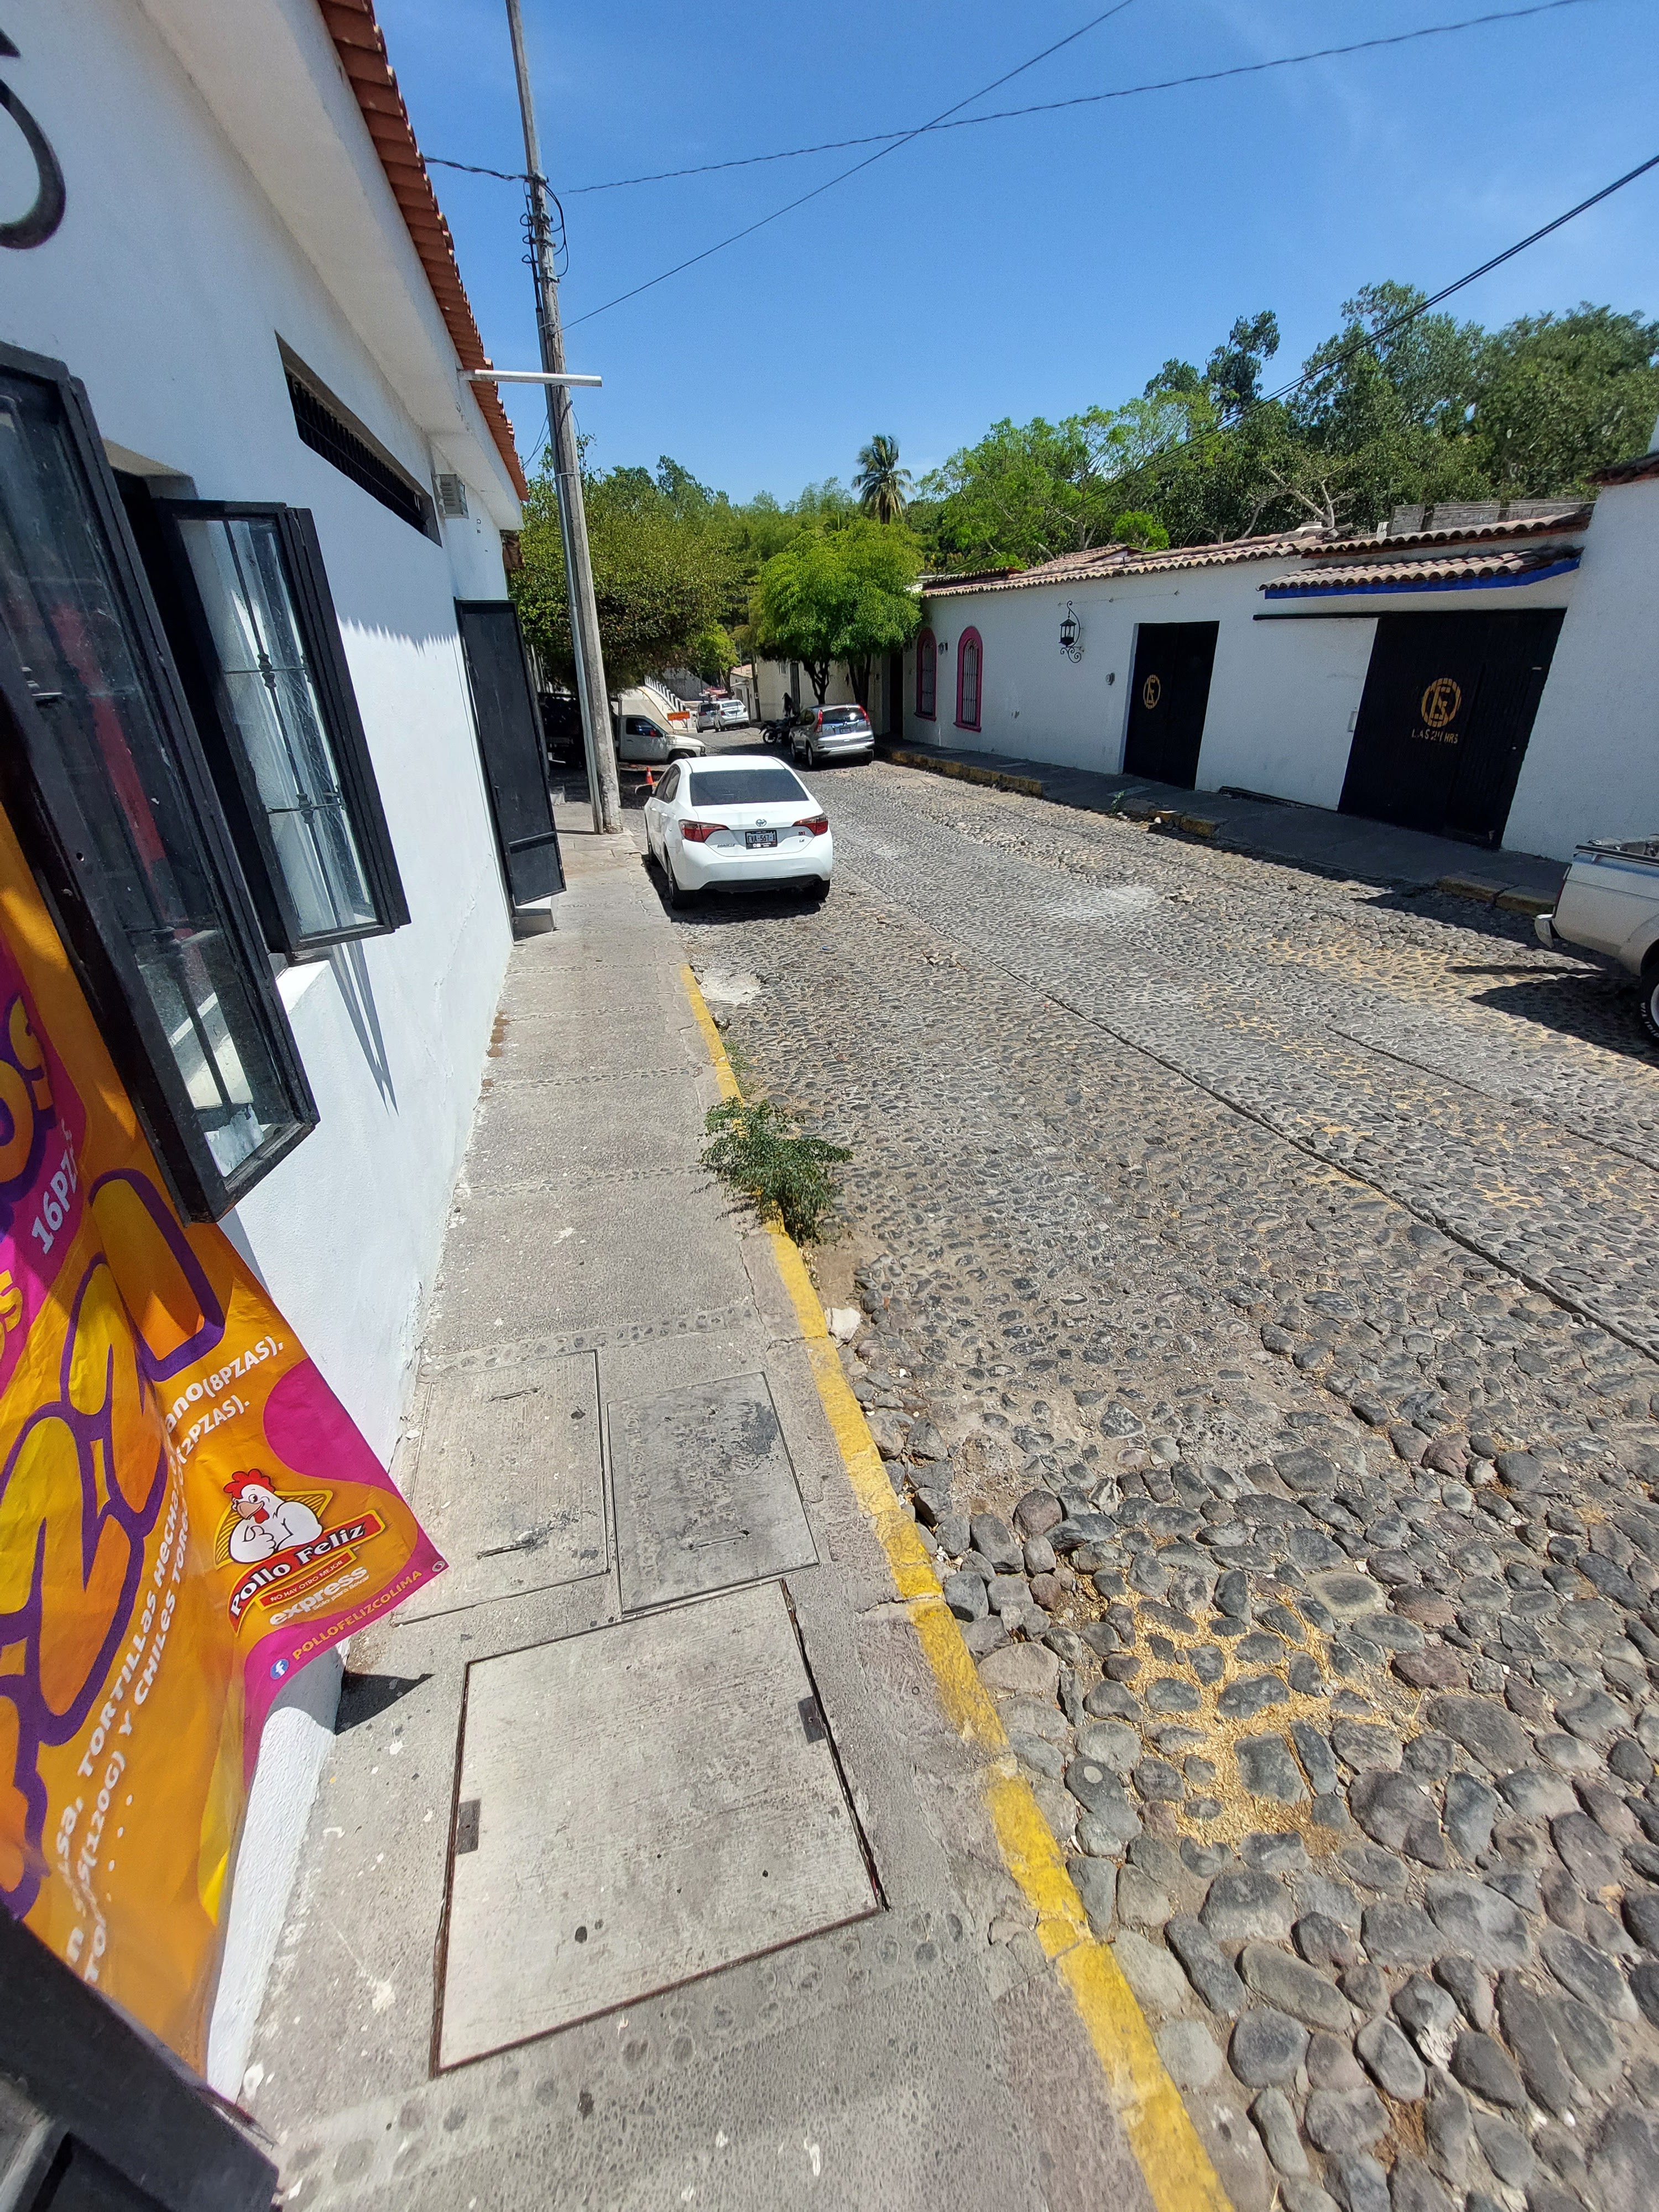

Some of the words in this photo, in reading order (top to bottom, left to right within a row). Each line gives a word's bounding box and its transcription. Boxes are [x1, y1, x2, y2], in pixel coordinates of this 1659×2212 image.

[230, 1563, 291, 1618] Pollo
[295, 1522, 366, 1566] Feliz
[269, 1566, 368, 1626] express
[283, 1587, 298, 1599] HAY
[299, 1576, 319, 1589] OTRO
[319, 1559, 343, 1577] MEJOR
[292, 1571, 422, 1660] POLLOFELIZCOLIMA
